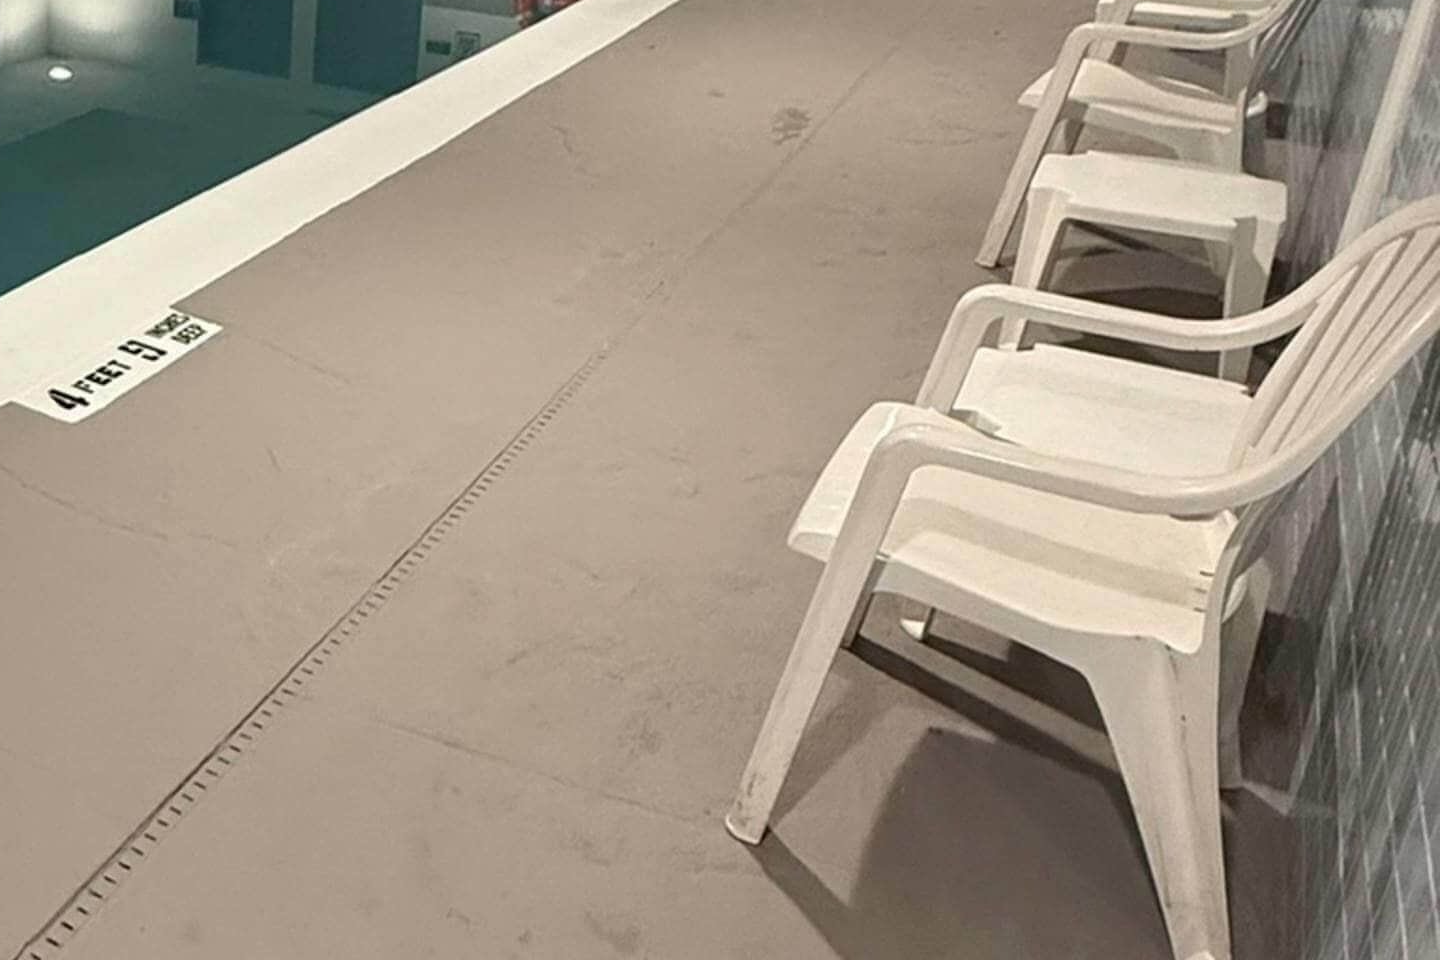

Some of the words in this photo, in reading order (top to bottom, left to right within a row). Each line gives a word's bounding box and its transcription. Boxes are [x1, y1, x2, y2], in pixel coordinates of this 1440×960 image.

[48, 388, 90, 410] 4
[72, 359, 132, 394] FEET
[117, 340, 168, 361] 9
